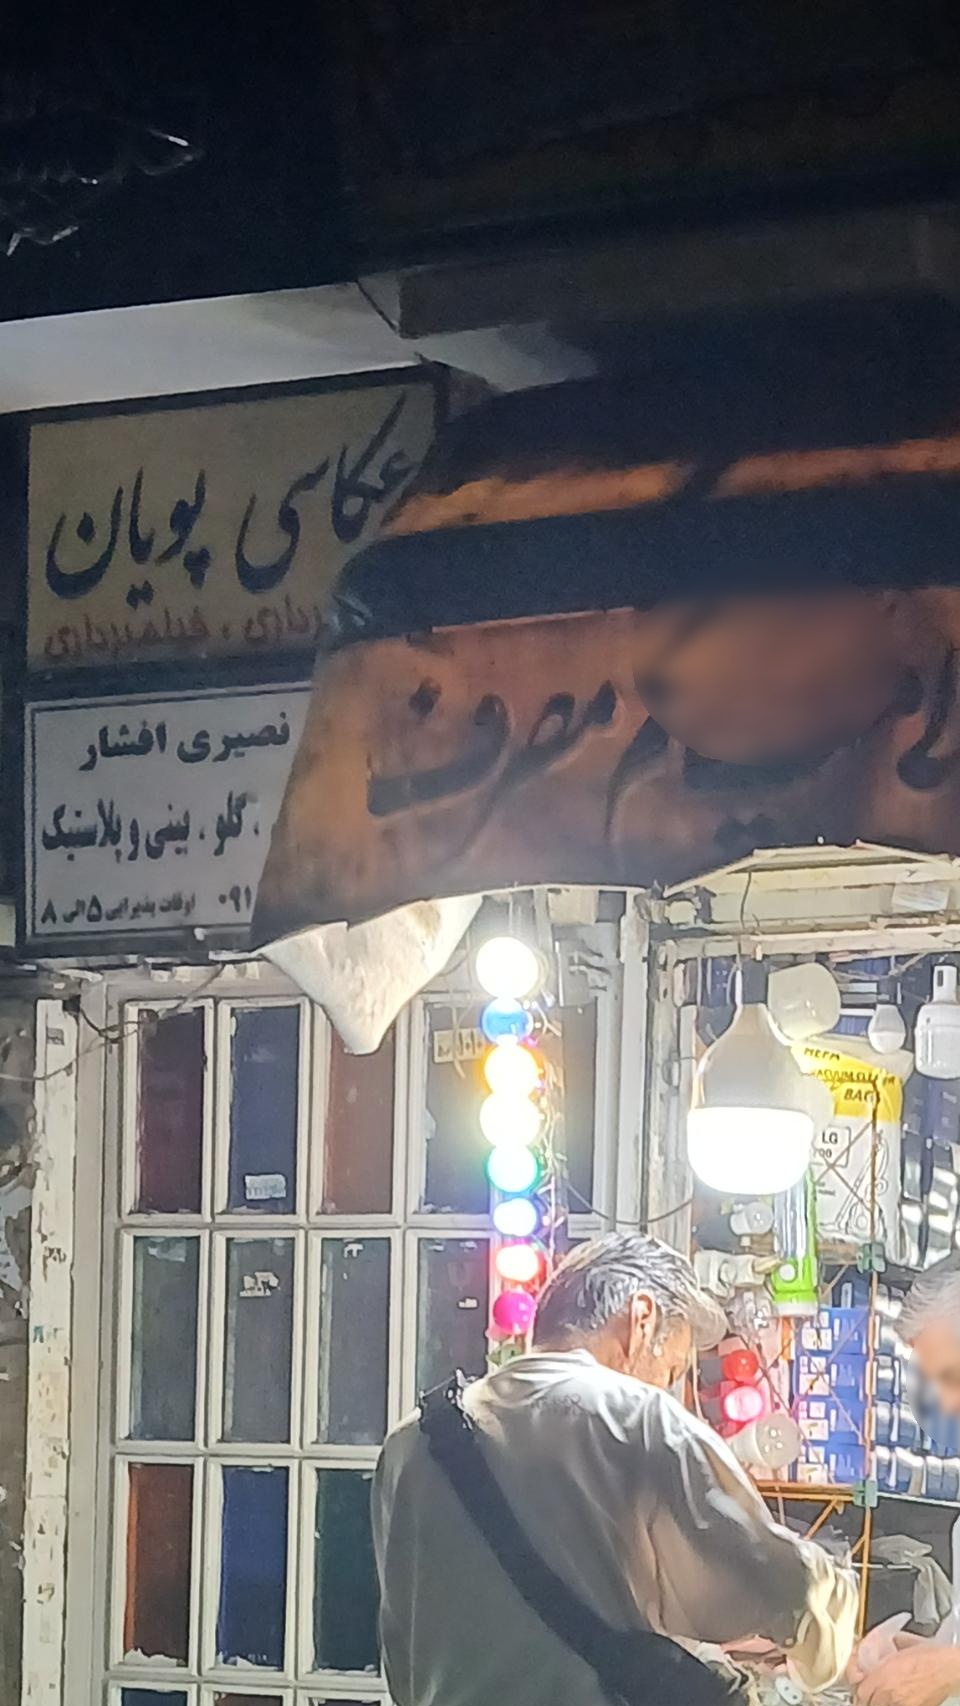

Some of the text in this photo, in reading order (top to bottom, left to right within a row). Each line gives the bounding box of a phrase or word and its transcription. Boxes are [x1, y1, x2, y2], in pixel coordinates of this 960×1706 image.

[45, 392, 412, 610] عکاسی پویان
[77, 711, 291, 771] نصیری افشار
[128, 818, 139, 861] و
[146, 803, 190, 860] بینی
[41, 898, 57, 924] ۸
[844, 1089, 878, 1102] BAG
[821, 1131, 839, 1145] LG
